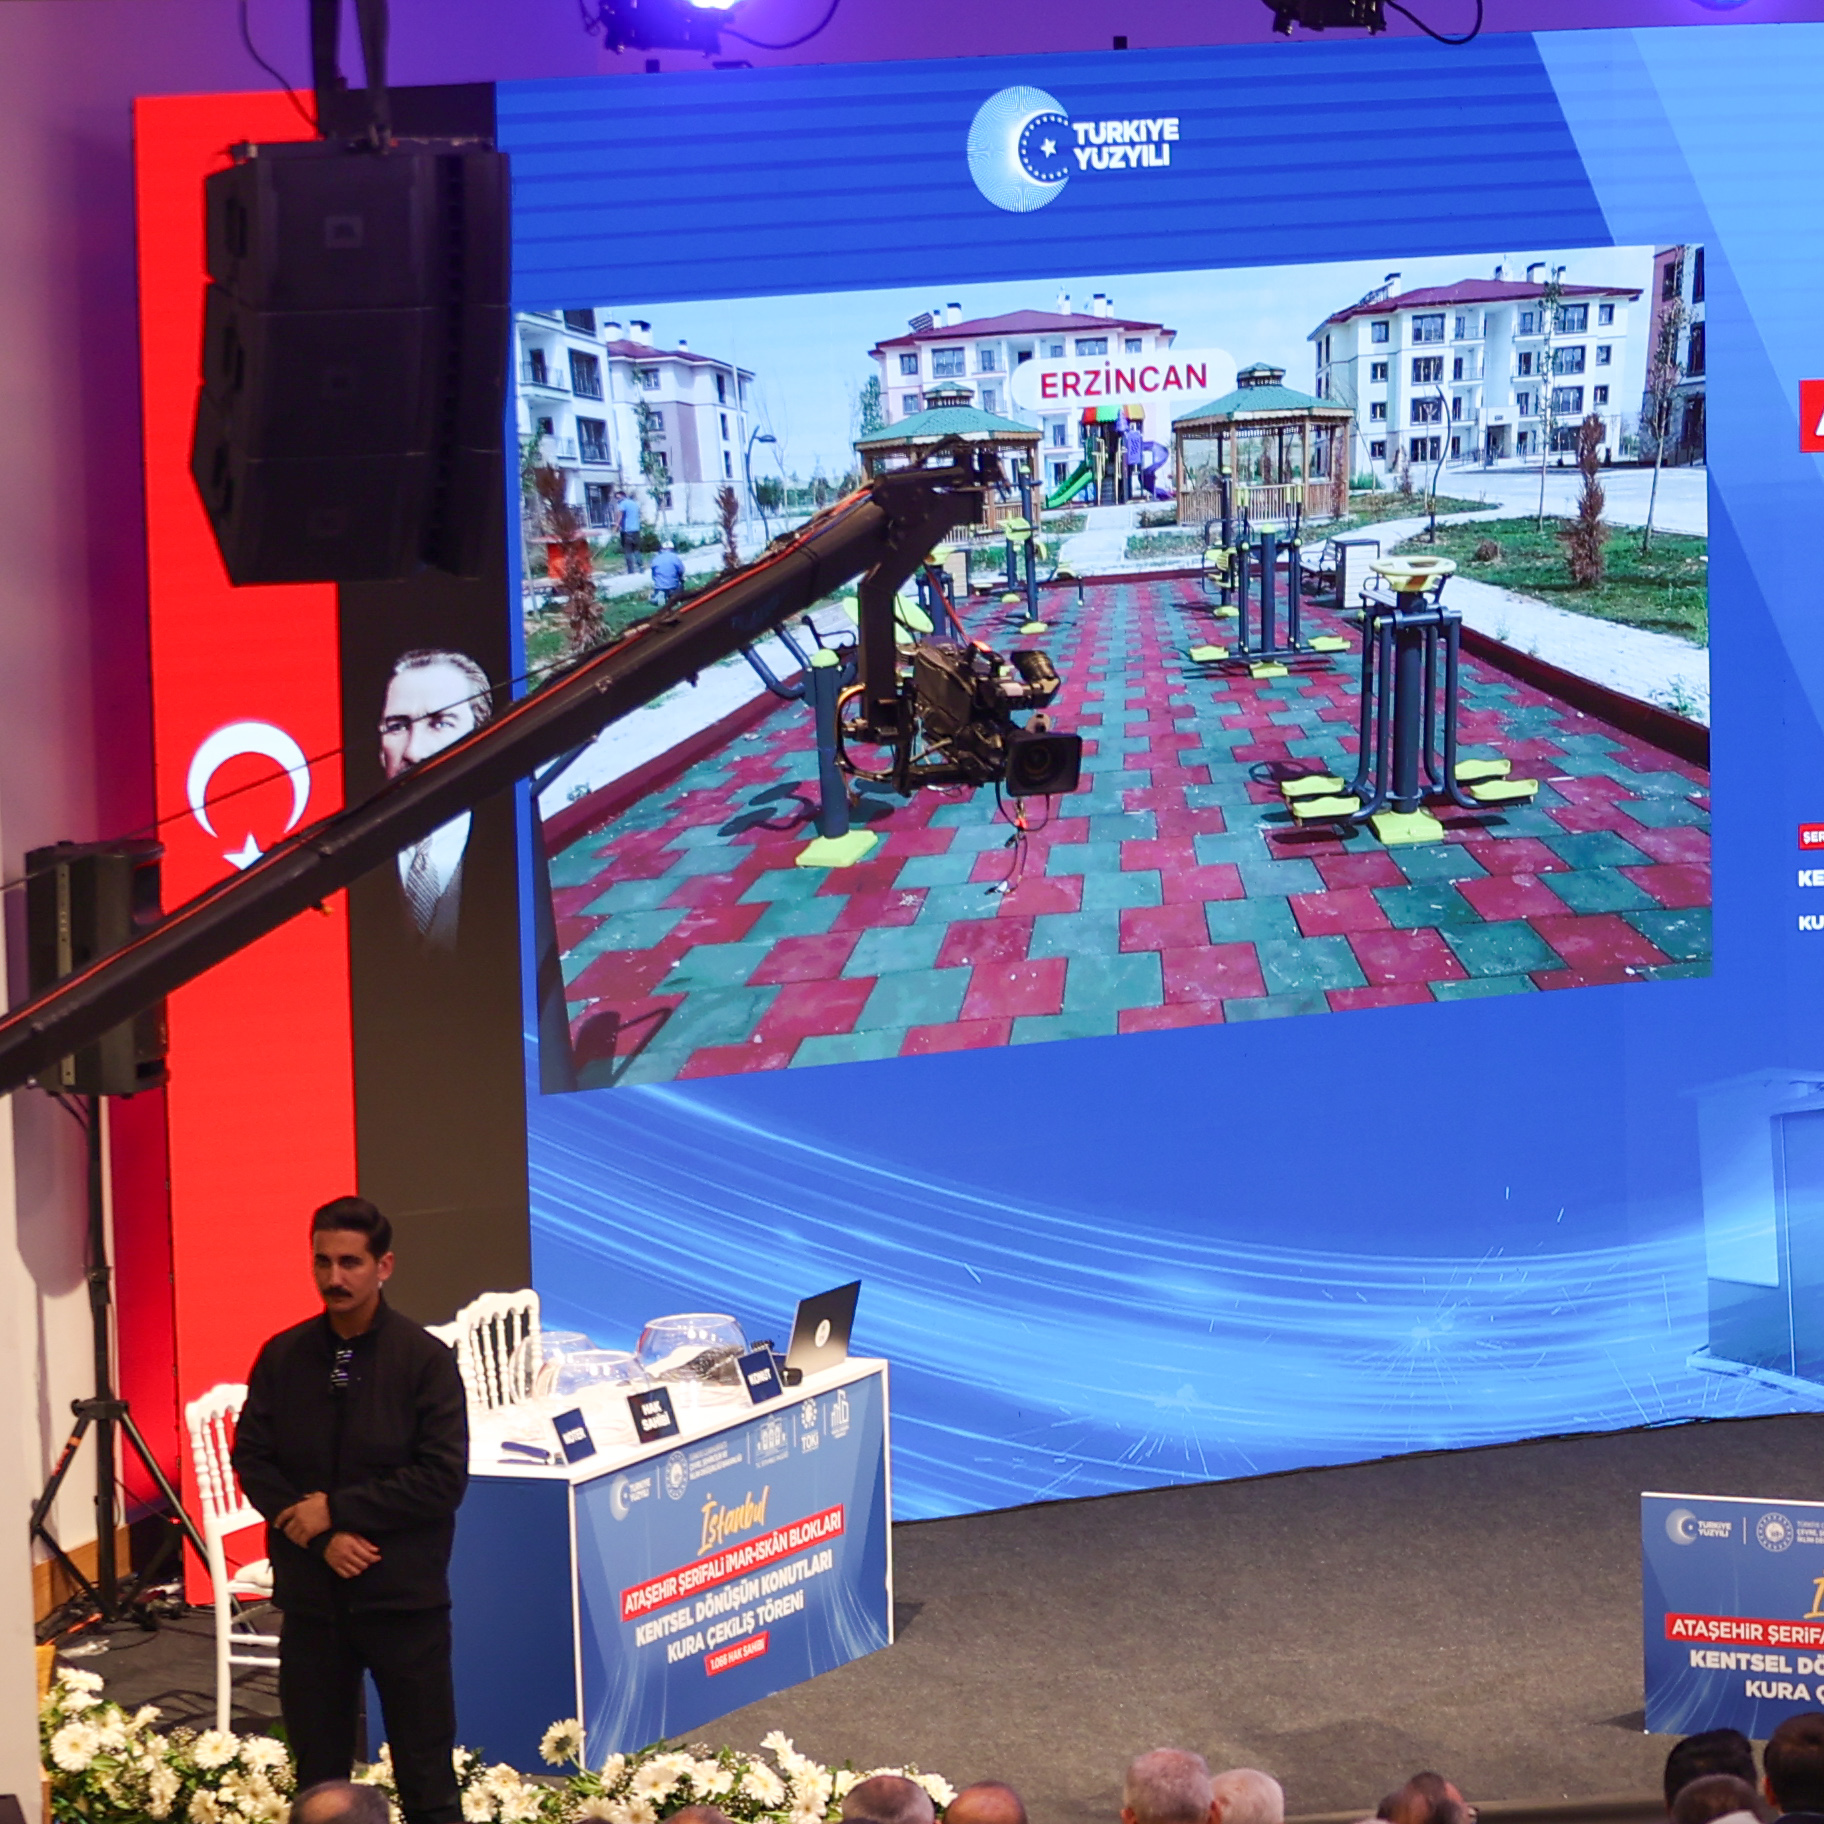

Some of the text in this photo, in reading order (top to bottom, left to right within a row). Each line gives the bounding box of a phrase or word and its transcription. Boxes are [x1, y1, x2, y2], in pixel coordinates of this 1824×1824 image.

[1041, 361, 1207, 398] ERZİNCAN
[641, 1401, 663, 1415] HAK
[697, 1485, 769, 1556] İstanbul
[625, 1510, 842, 1614] ATAŞEHİR ŞERİFALİ İMAR-İSKÂN BLOKLARI
[635, 1549, 833, 1648] KENTSEL DÖNÜŞÜM KONUTLARI
[667, 1590, 805, 1664] KURA ÇEKİLİŞ TÖRENİ
[1672, 1619, 1763, 1641] ATAŞEHİR
[728, 1648, 742, 1662] HAK
[1690, 1650, 1794, 1675] KENTSEL
[1746, 1680, 1811, 1701] KURA
